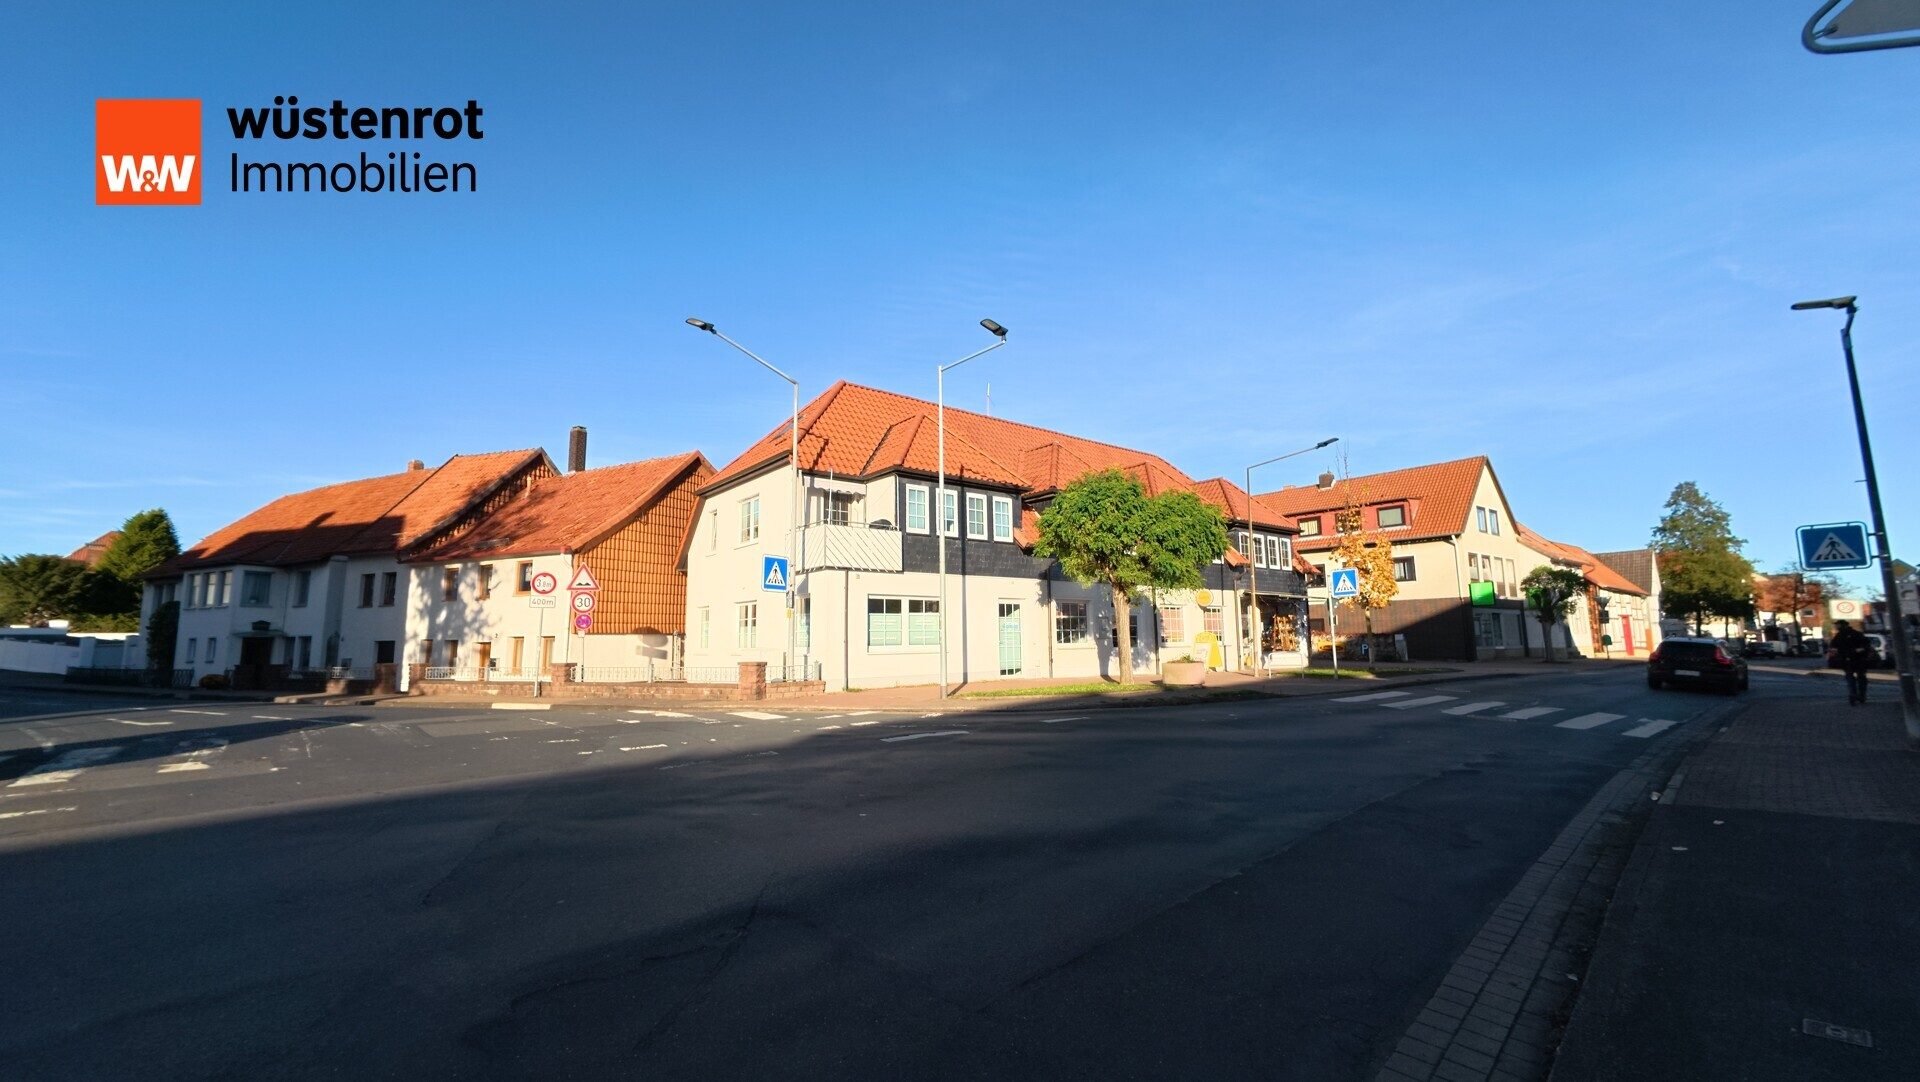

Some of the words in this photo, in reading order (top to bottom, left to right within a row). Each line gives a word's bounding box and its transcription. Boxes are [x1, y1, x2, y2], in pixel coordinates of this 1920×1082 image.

[531, 598, 554, 606] 400m
[576, 597, 591, 608] 30
[1361, 643, 1369, 655] P
